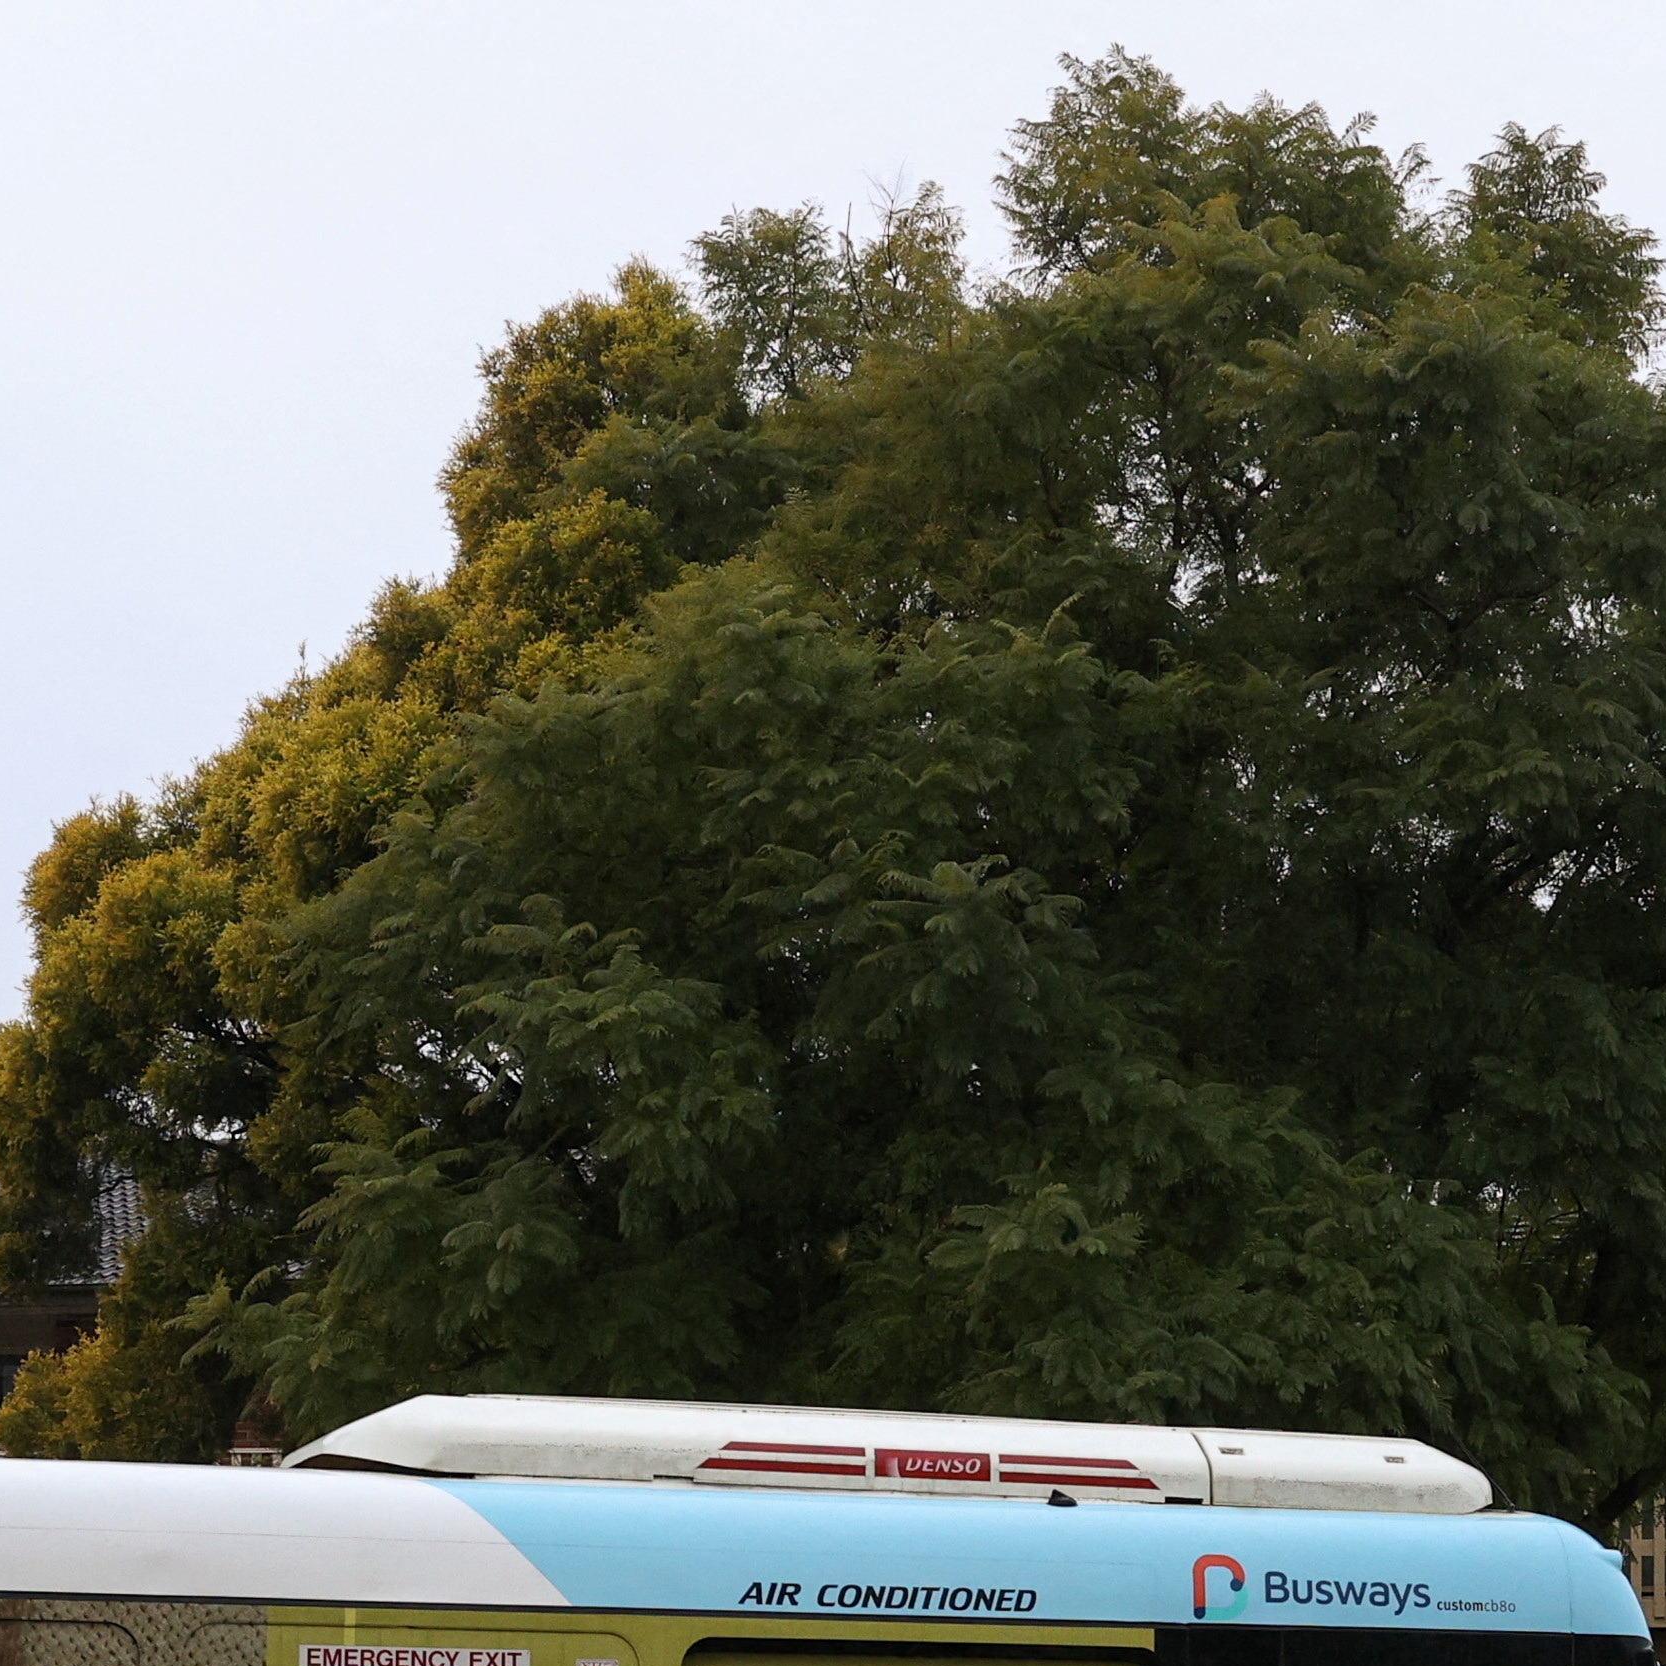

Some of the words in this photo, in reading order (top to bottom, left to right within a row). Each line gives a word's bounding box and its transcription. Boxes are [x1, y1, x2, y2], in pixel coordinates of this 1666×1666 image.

[905, 1457, 981, 1475] DENSO
[738, 1582, 801, 1606] AIR
[817, 1584, 1037, 1612] CONDITIONED
[1265, 1571, 1431, 1616] Busways
[1436, 1598, 1516, 1613] customcb80
